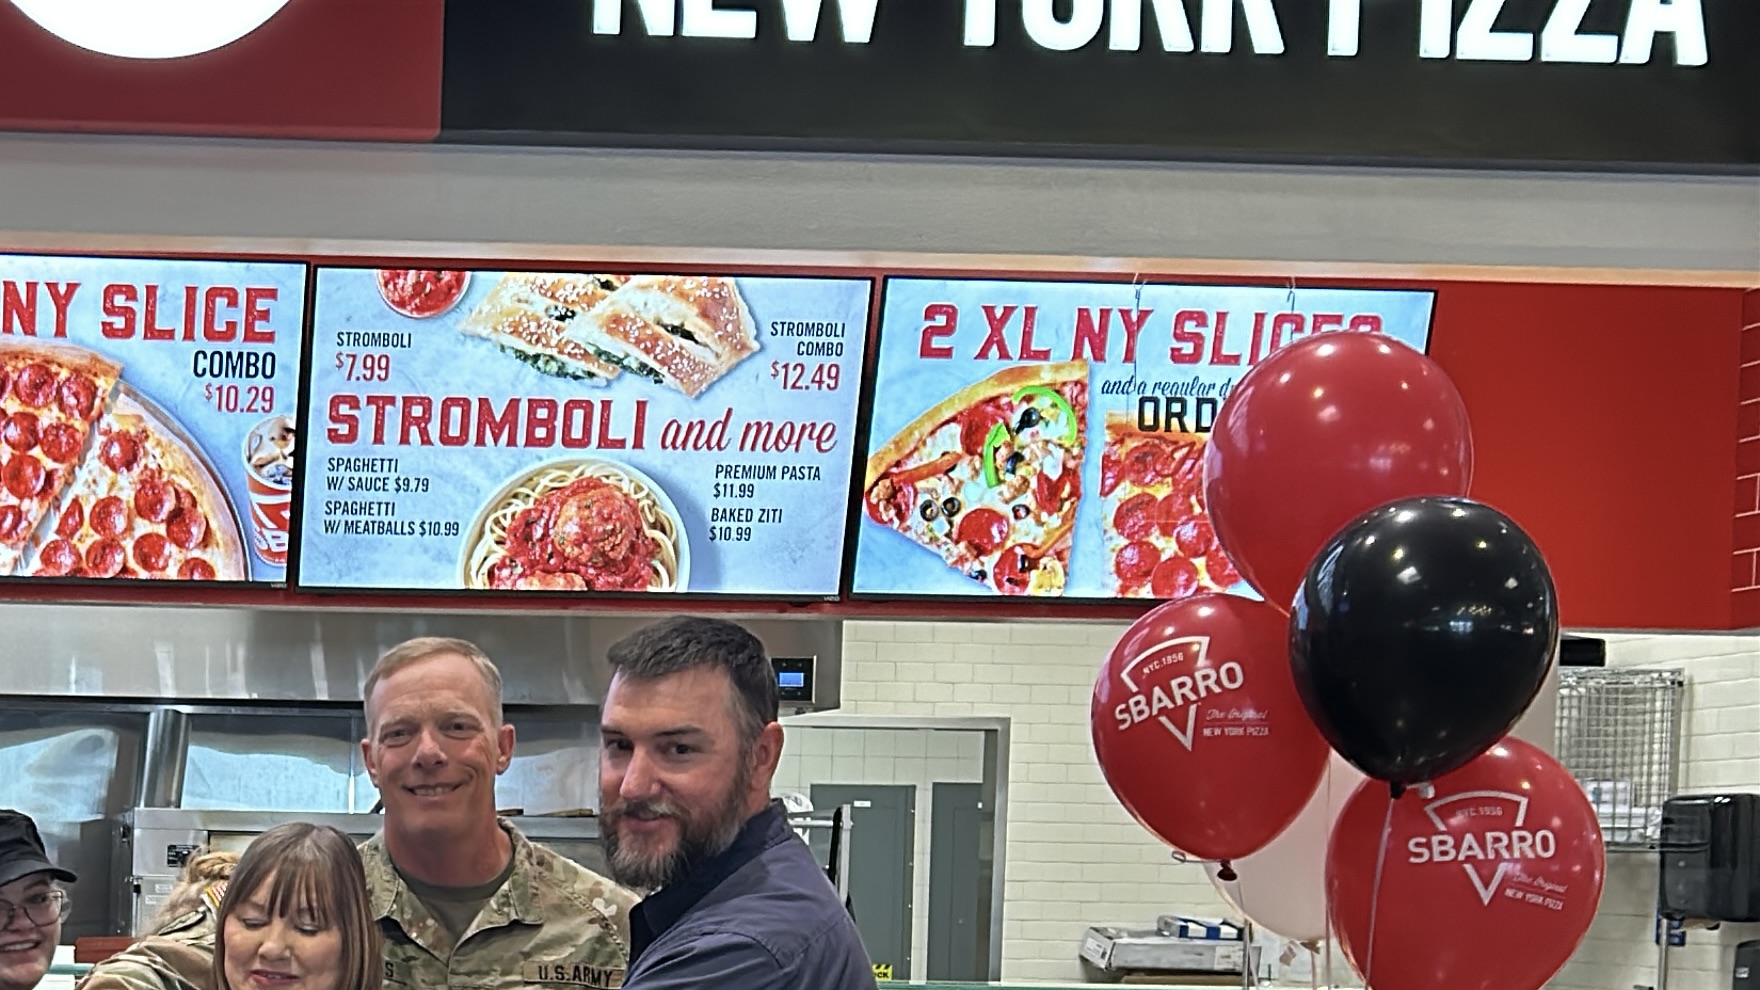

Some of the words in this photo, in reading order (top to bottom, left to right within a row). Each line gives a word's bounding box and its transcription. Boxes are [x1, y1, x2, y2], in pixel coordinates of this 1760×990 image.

[1, 280, 80, 338] NY
[100, 283, 278, 343] SLICE
[770, 320, 846, 339] STROMBOLI
[918, 303, 959, 361] 2
[973, 304, 1052, 362] XL
[1071, 306, 1154, 364] NY
[336, 331, 413, 350] STROMBOLI
[796, 340, 844, 357] COMBO
[193, 350, 277, 380] COMBO
[335, 352, 392, 383] $7.99
[769, 361, 841, 391] $12.49
[1101, 374, 1135, 395] and
[1152, 376, 1216, 396] regular
[204, 383, 275, 414] $10.29
[326, 393, 649, 450] STROMBOLI
[659, 407, 733, 451] and
[738, 425, 838, 454] more
[327, 457, 400, 475] SPAGHETTI
[715, 464, 778, 481] PREMIUM
[781, 466, 821, 482] PASTA
[325, 475, 343, 492] W/
[348, 476, 390, 492] SAUCE
[394, 475, 430, 494] $9.79
[713, 481, 755, 499] $11.99
[325, 500, 396, 518] SPAGHETTI
[711, 506, 754, 524] BAKED
[757, 507, 783, 524] ZITI
[323, 518, 341, 535] W/
[342, 519, 415, 536] MEATBALLS
[418, 520, 460, 537] $10.99
[709, 525, 752, 543] $10.99
[1114, 661, 1244, 731] SBARRO
[1203, 728, 1222, 737] NEW
[1224, 727, 1245, 736] YORK
[1246, 727, 1269, 736] PIZZA
[1408, 829, 1556, 863] SBARRO
[1505, 888, 1524, 900] NEW
